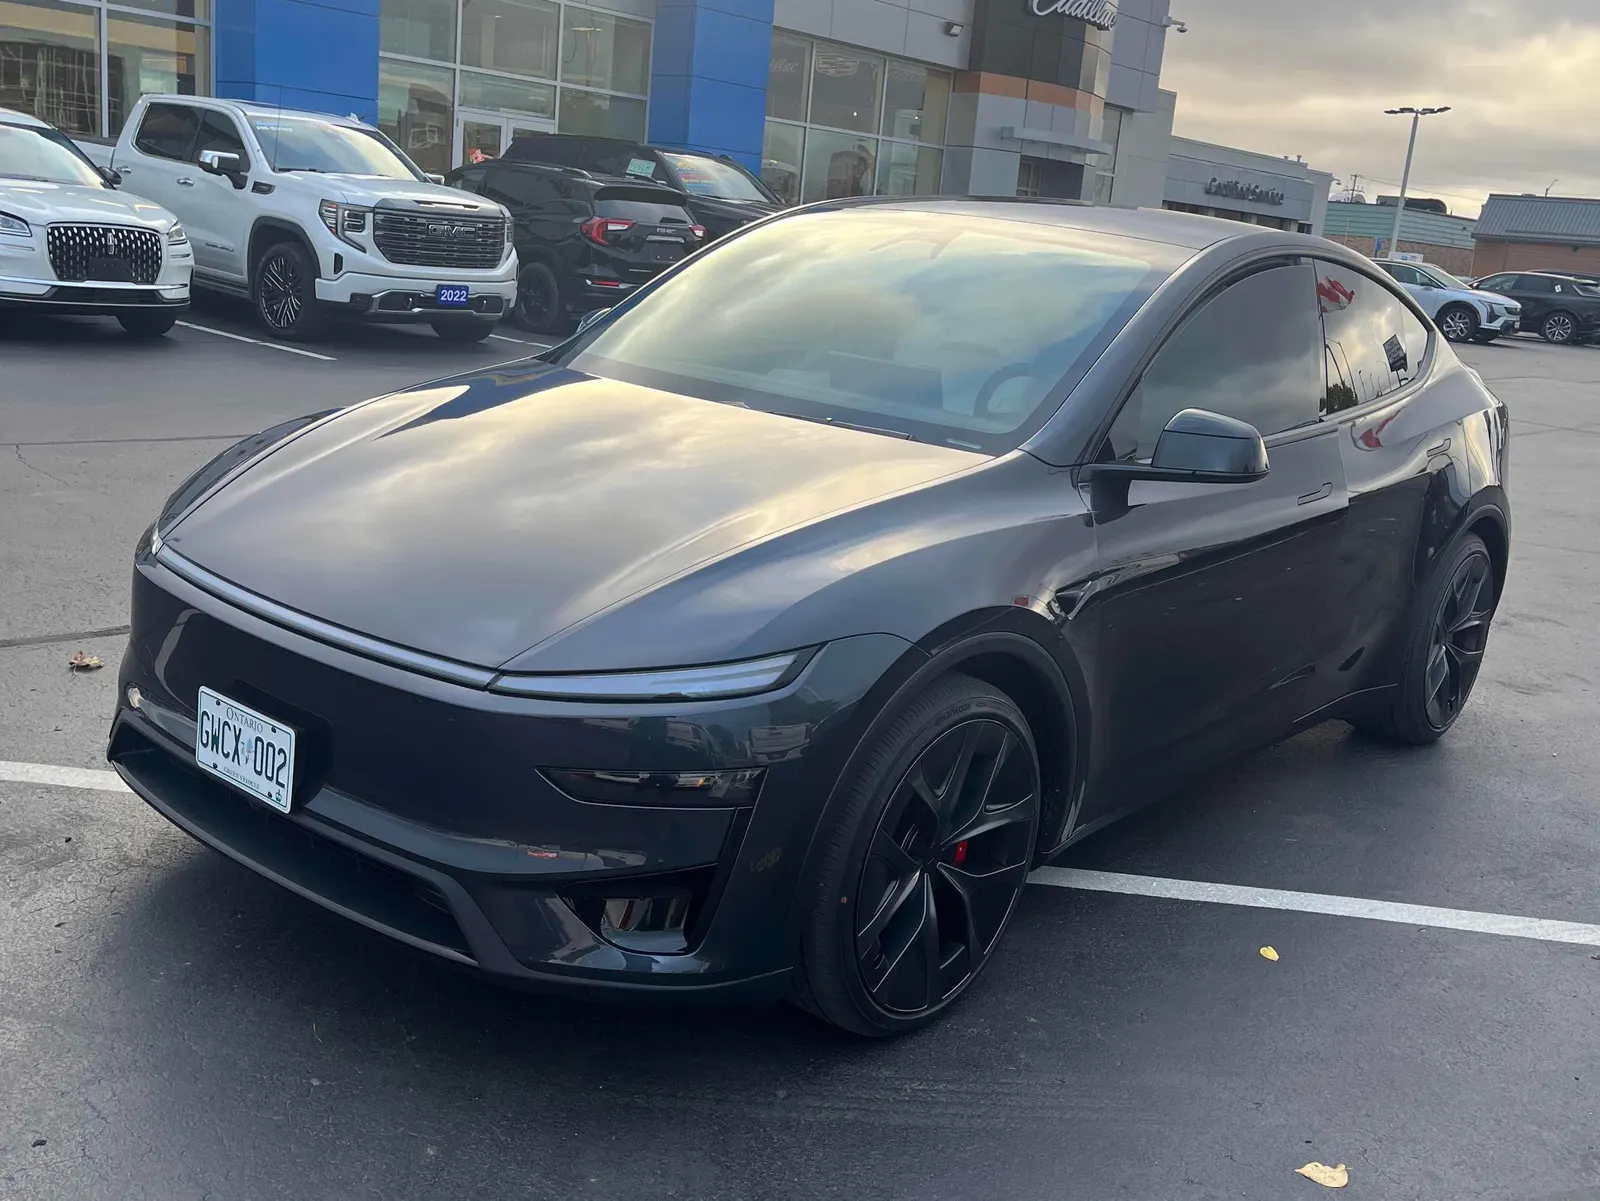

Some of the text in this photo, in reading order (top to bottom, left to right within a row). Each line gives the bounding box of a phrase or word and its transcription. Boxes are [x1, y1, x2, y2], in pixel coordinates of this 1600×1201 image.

[428, 224, 476, 238] GMC
[440, 289, 467, 302] 2022
[200, 710, 287, 789] GWCX 002
